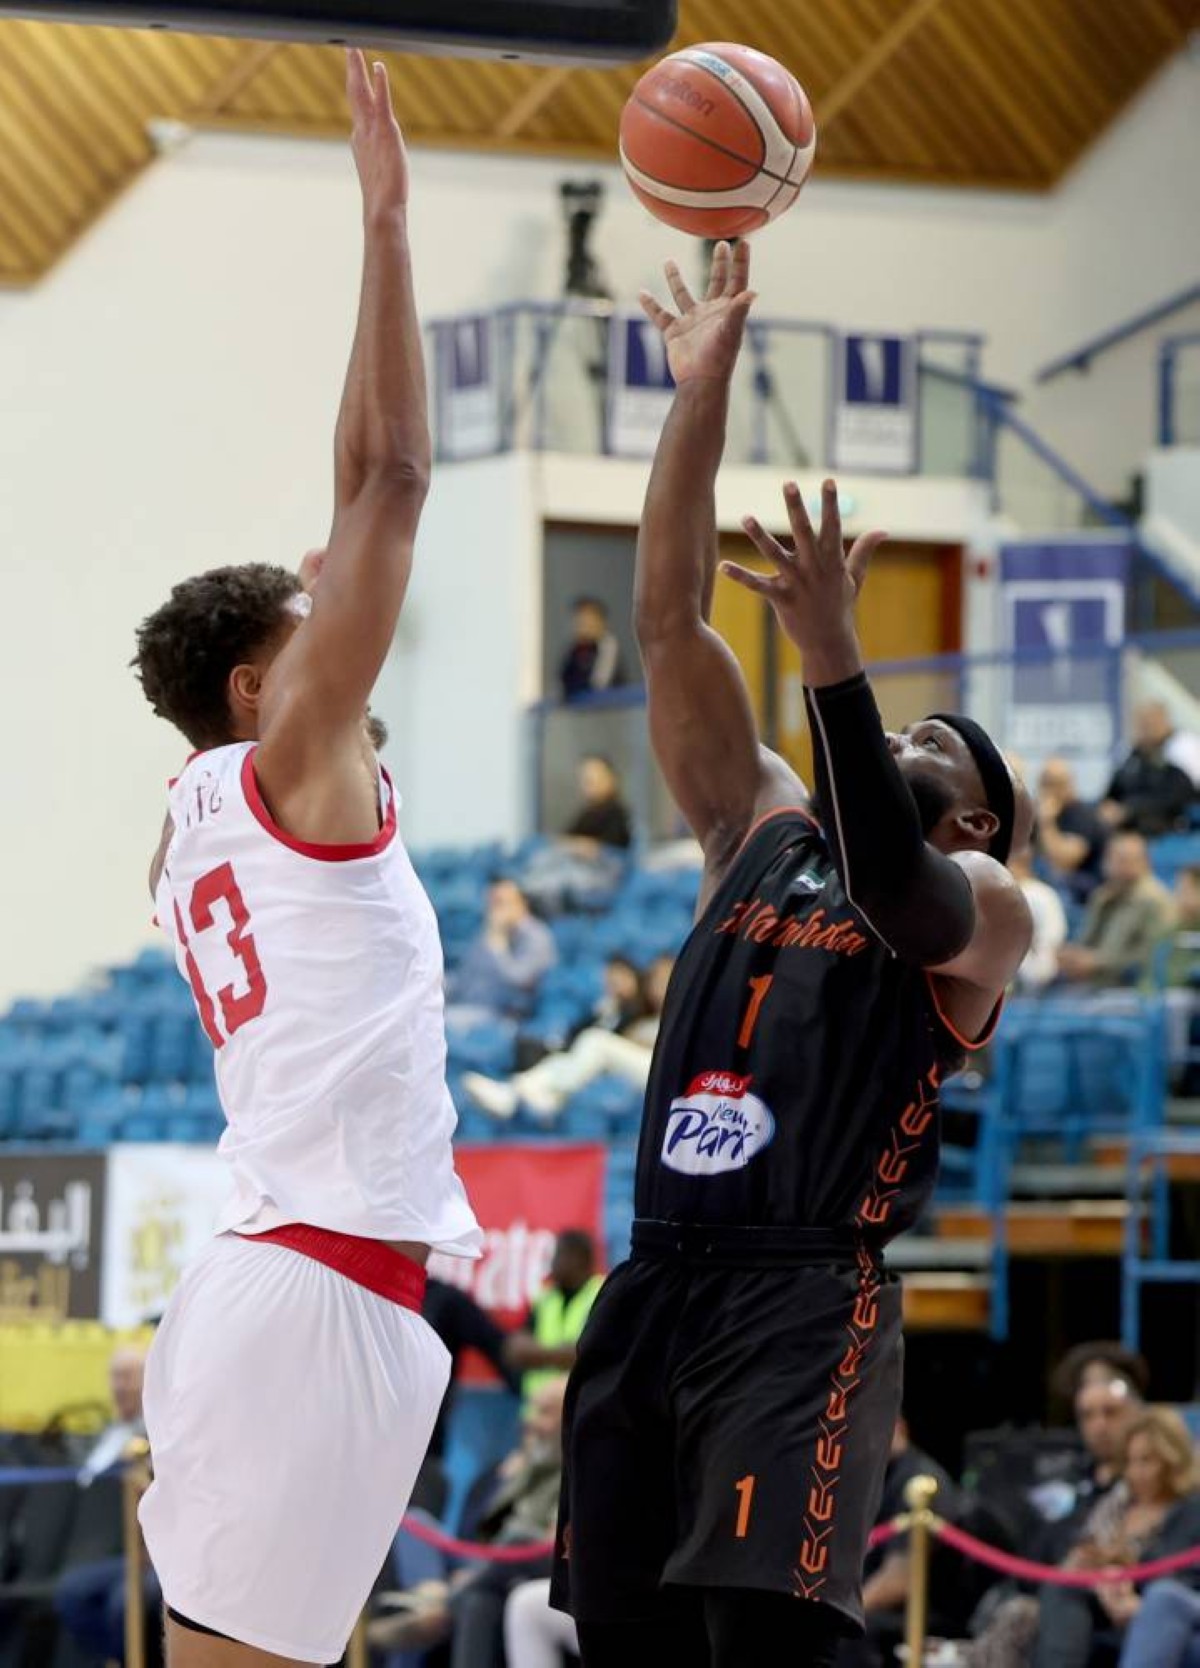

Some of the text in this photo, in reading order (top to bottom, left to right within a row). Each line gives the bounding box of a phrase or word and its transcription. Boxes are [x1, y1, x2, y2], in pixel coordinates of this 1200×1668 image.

[737, 974, 774, 1048] 1
[668, 1108, 753, 1159] Park
[735, 1475, 756, 1537] 1
